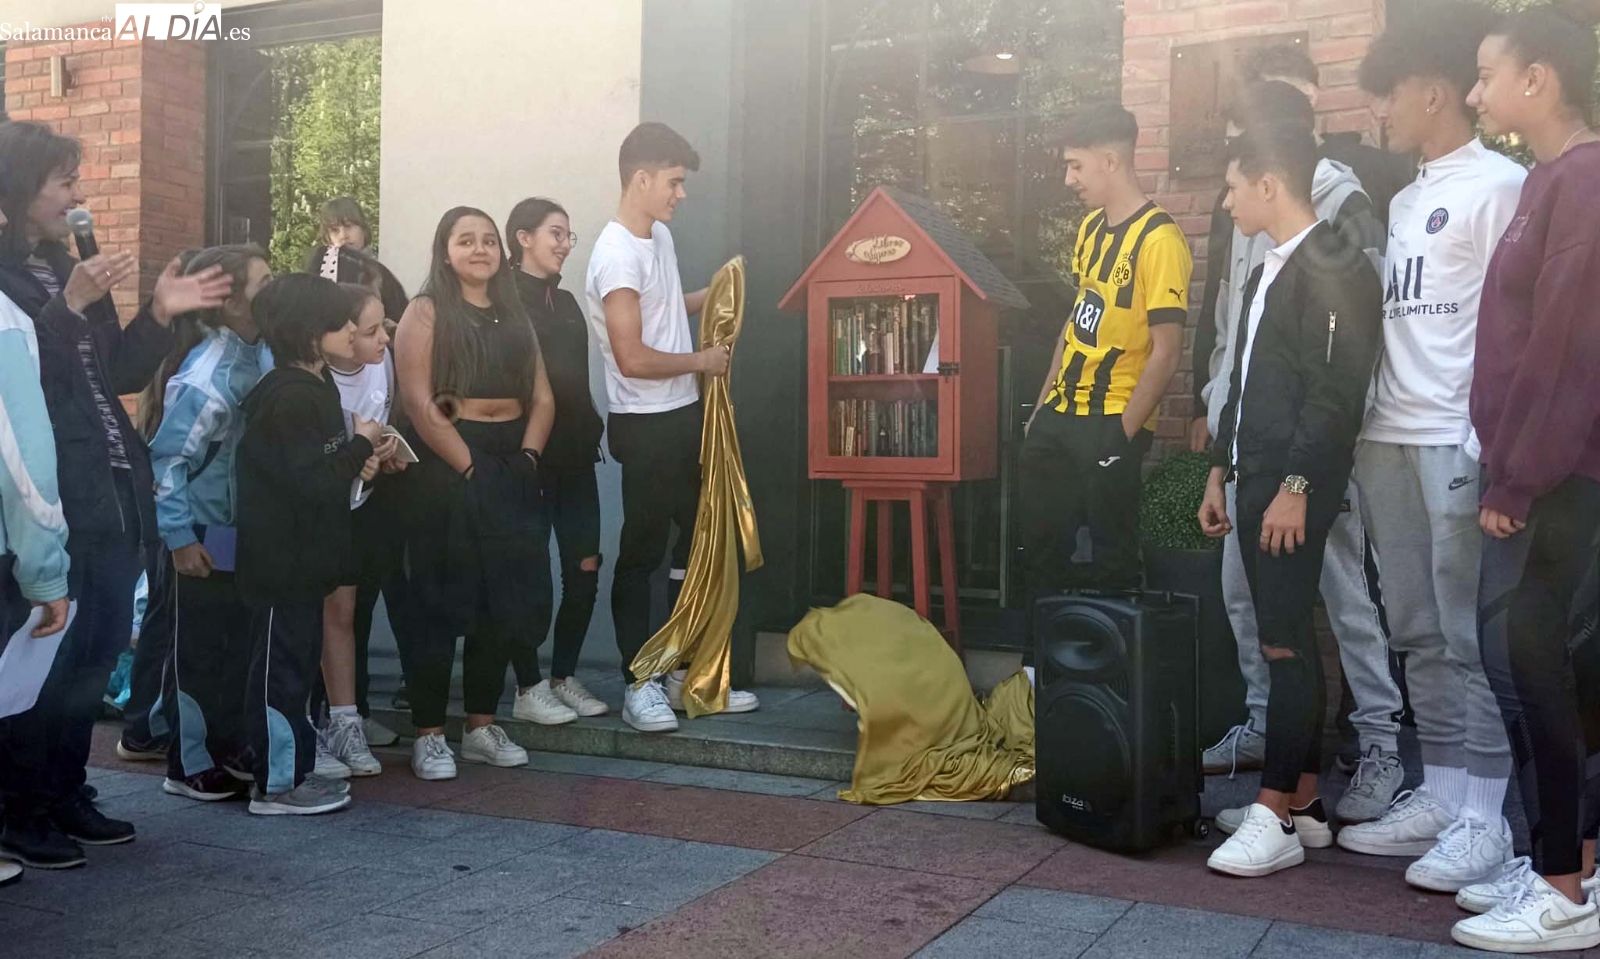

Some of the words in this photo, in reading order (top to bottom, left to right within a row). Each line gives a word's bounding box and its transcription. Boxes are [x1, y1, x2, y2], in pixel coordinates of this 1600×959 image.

[1115, 263, 1130, 280] BVB
[1076, 299, 1101, 334] 1&1
[1402, 302, 1459, 317] LIMITLESS
